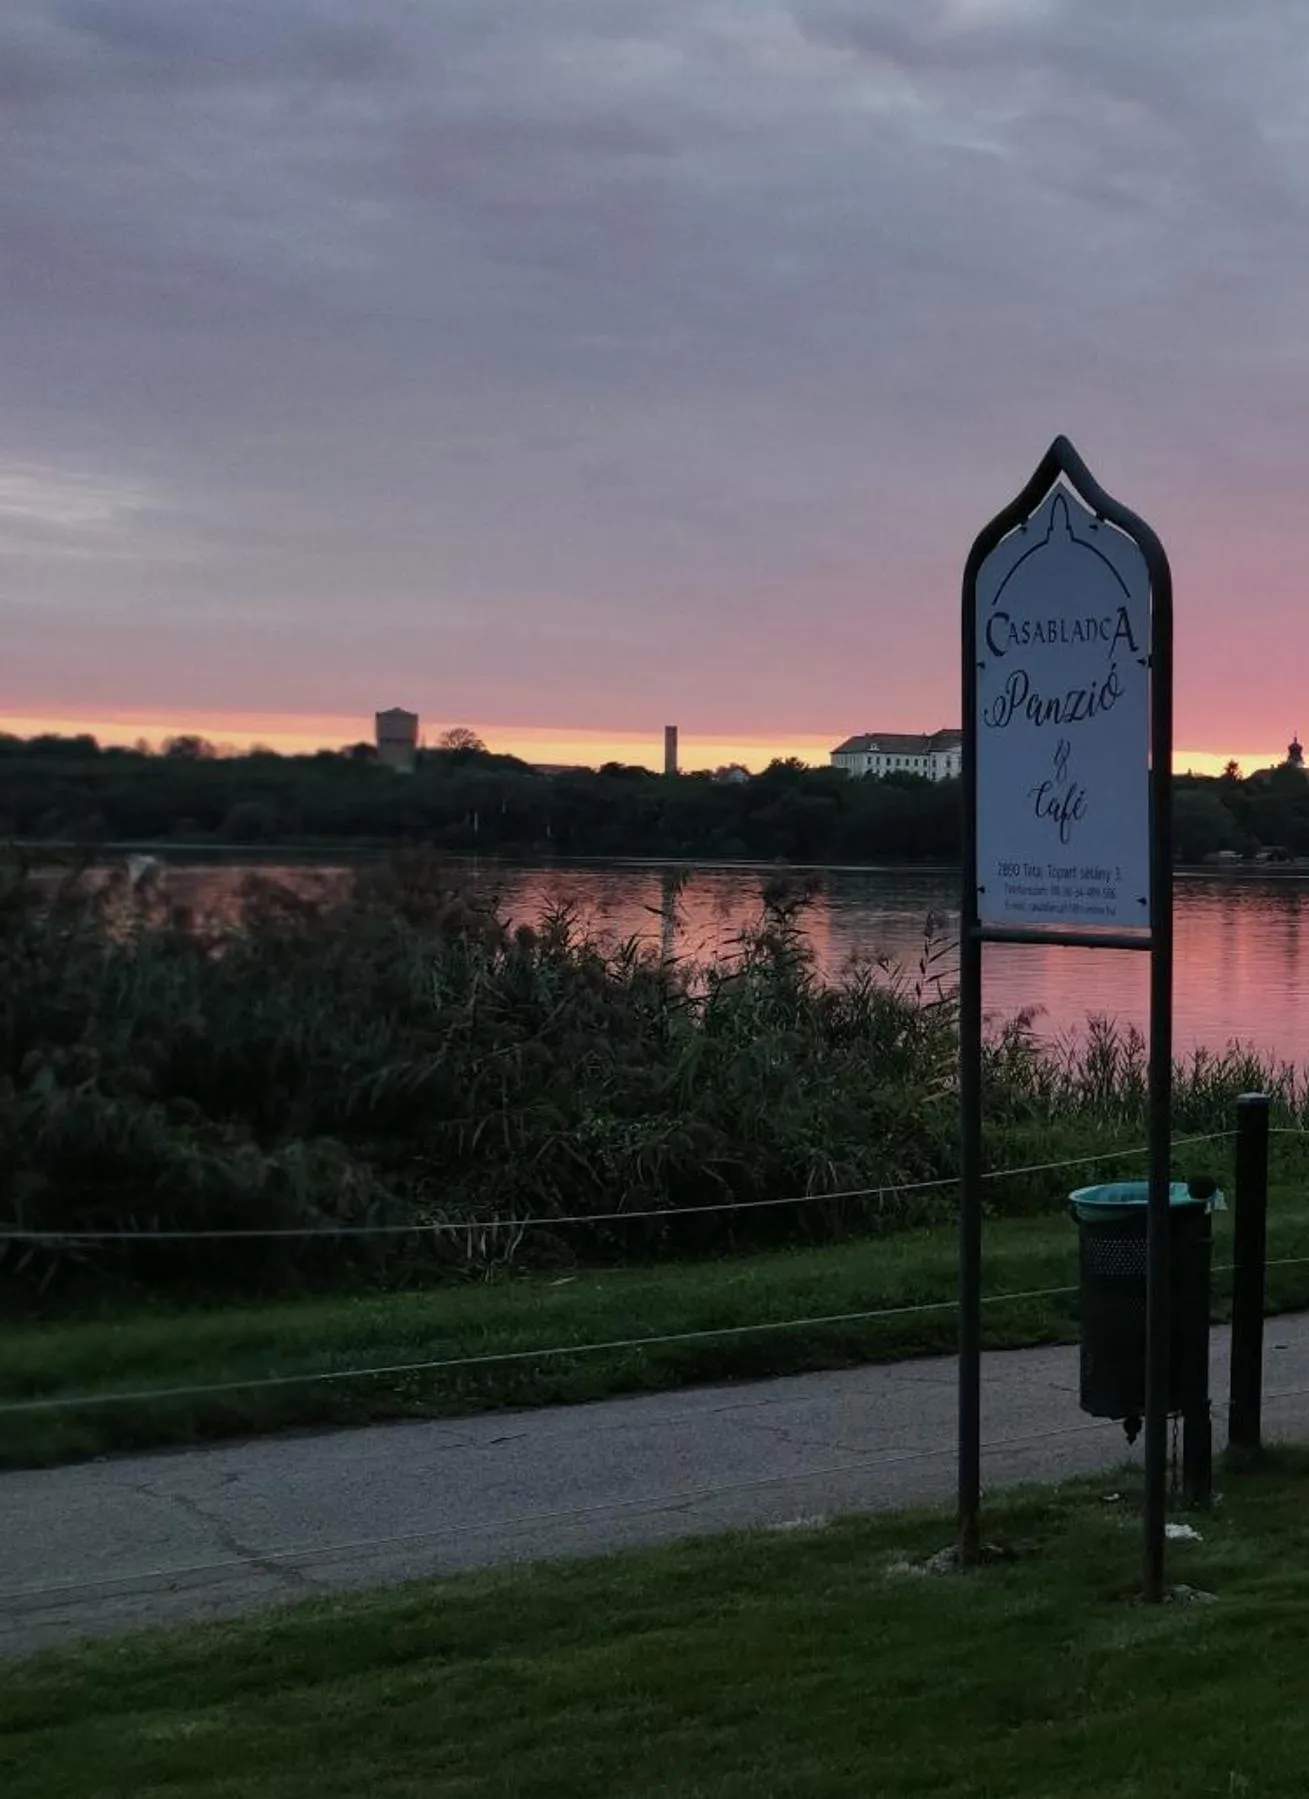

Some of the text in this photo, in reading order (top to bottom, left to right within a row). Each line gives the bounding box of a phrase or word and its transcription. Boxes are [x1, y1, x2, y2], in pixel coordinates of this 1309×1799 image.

[985, 606, 1140, 658] CASABLANCA
[983, 662, 1127, 729] Panzió
[1025, 779, 1089, 846] Café
